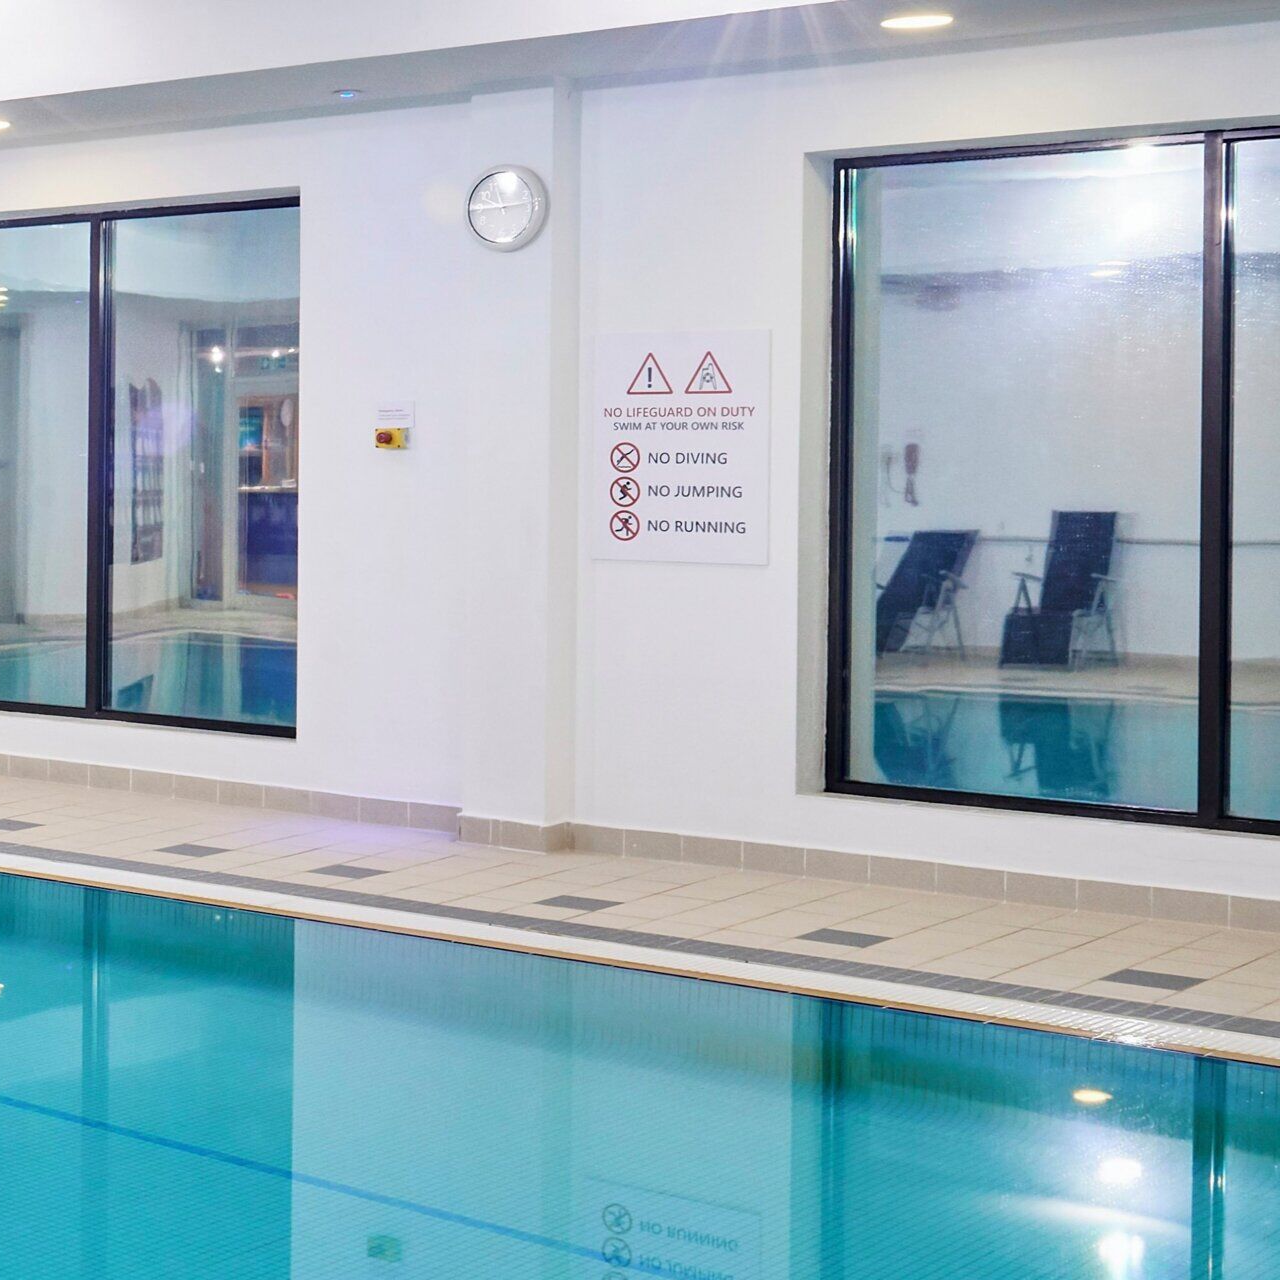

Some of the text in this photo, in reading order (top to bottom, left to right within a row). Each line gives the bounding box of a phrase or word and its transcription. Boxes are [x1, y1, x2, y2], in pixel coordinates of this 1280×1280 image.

[604, 406, 755, 417] NO LIFEGUARD ON DUTY
[613, 421, 744, 430] SWIM AT YOUR OWN RISK
[647, 452, 728, 465] NO DIVING
[647, 485, 743, 498] NO JUMPING
[647, 520, 746, 534] NO RUNNING
